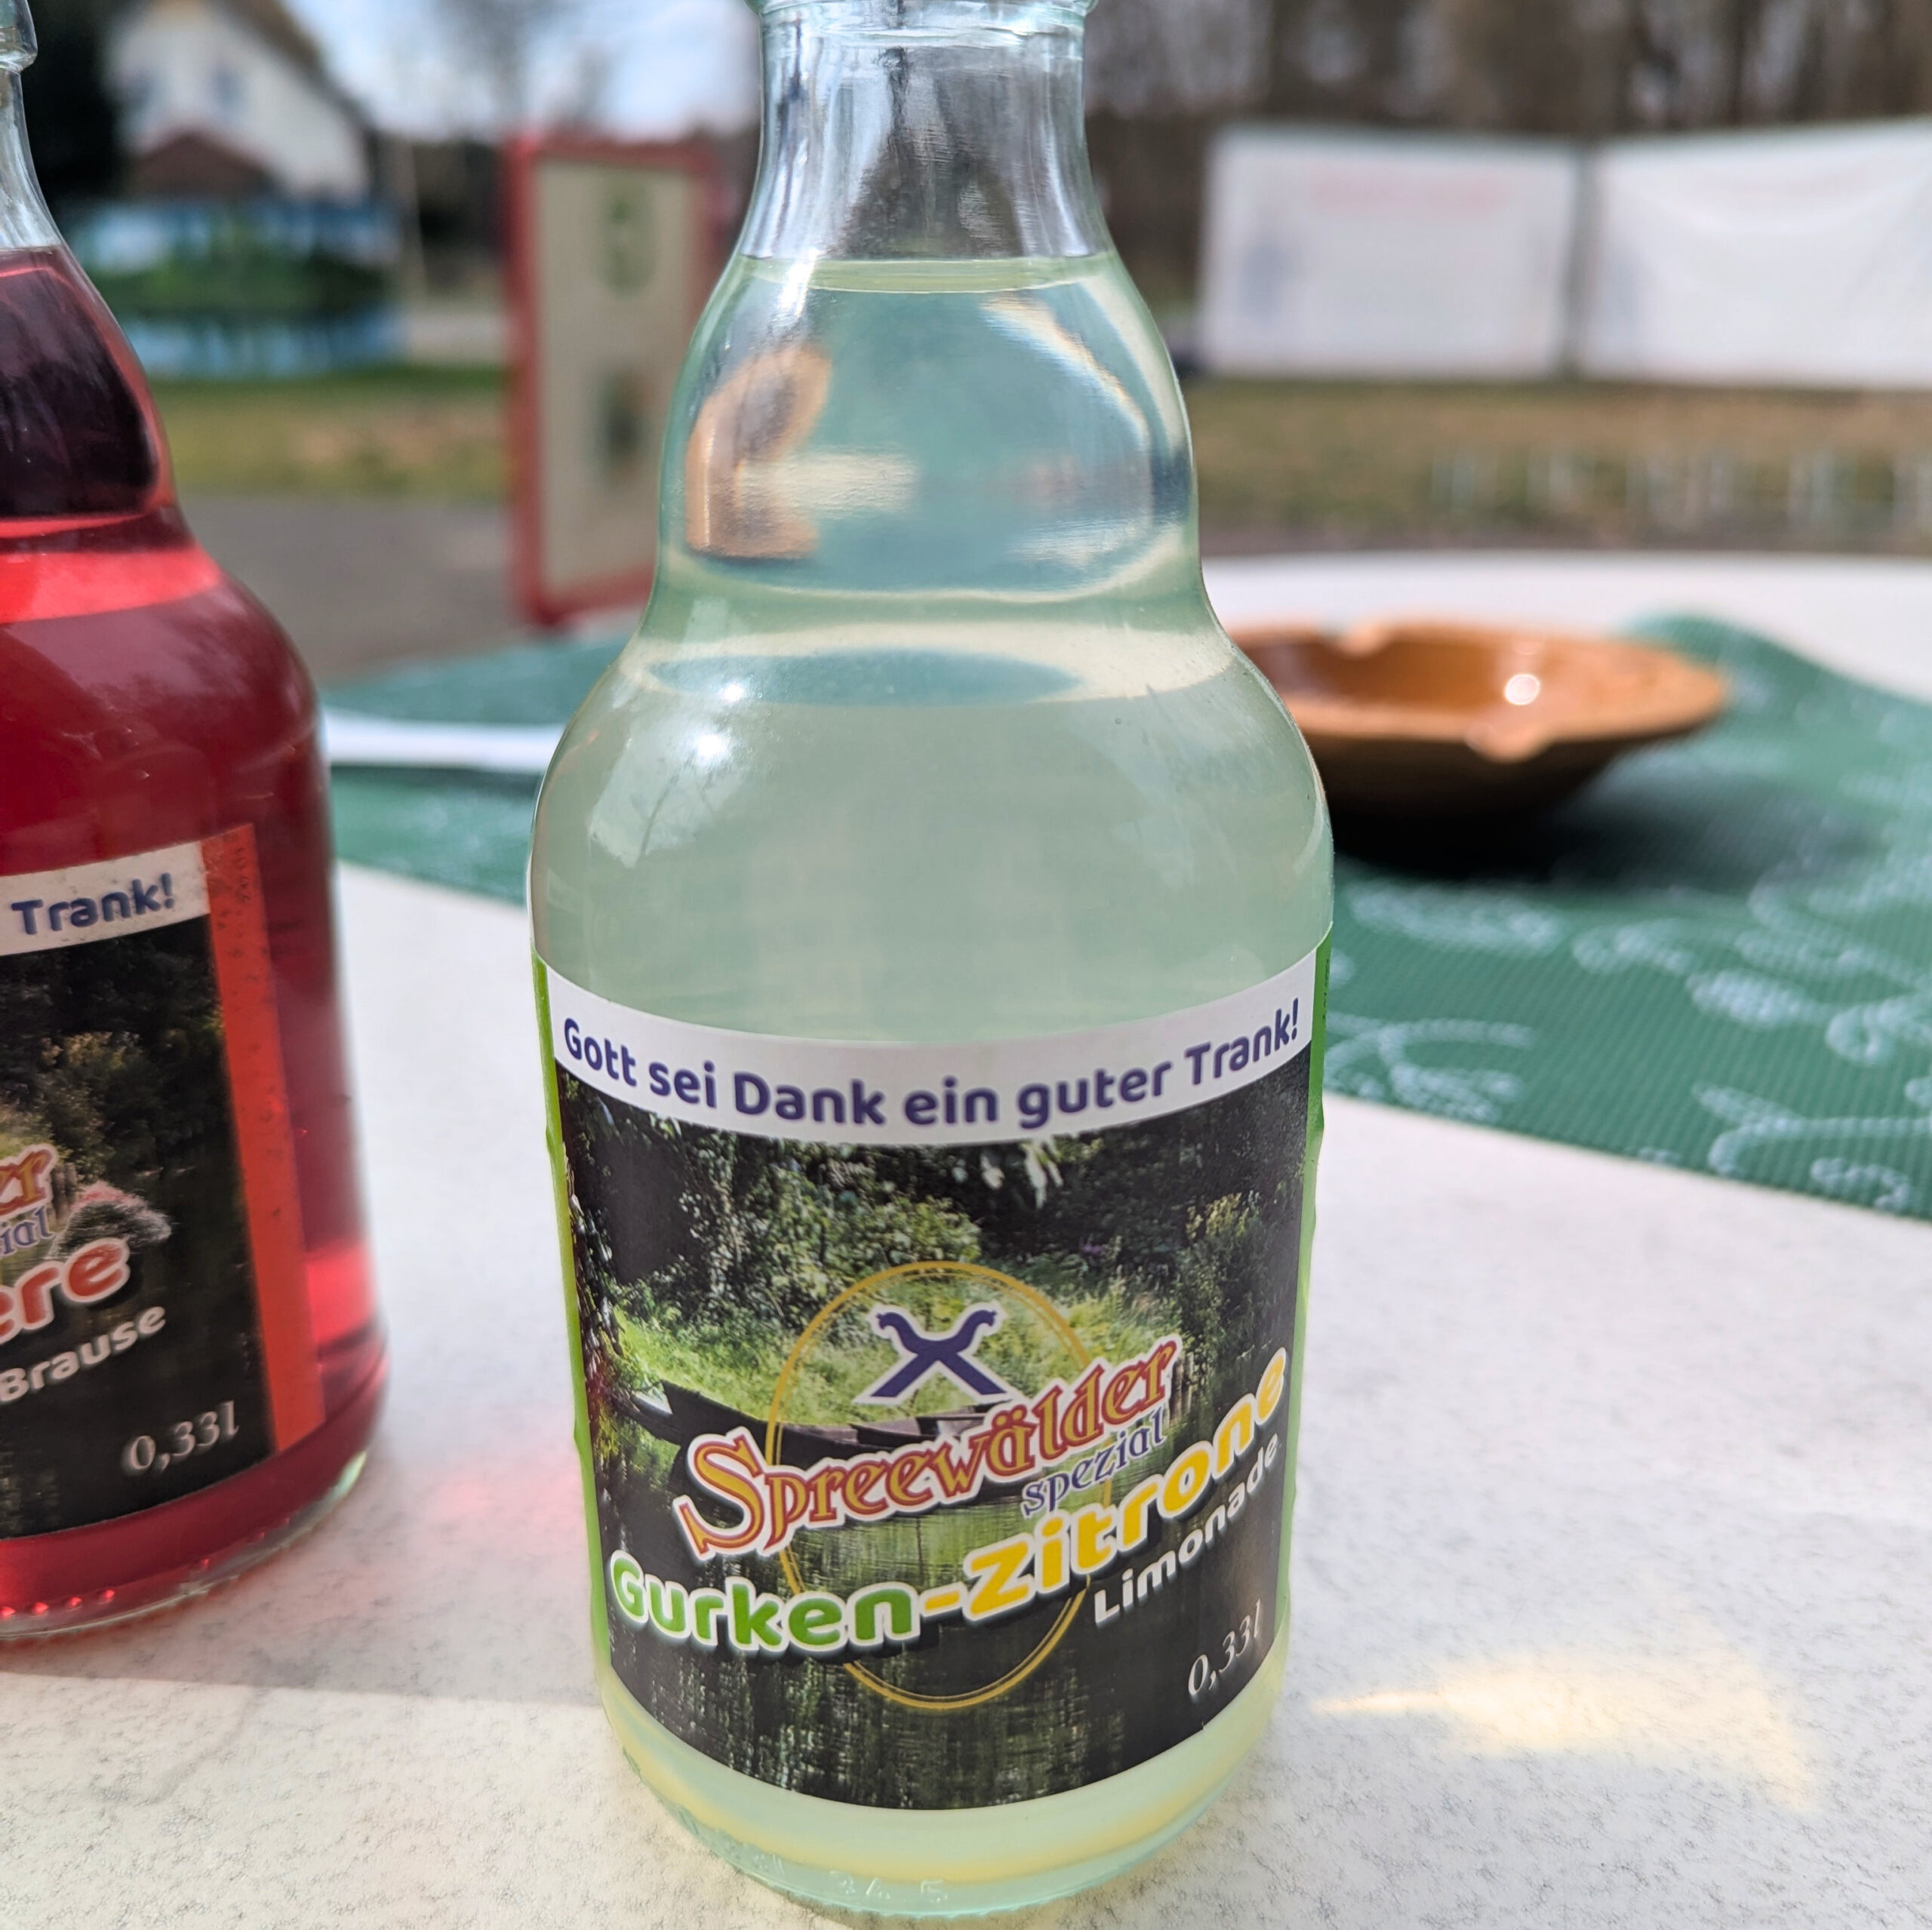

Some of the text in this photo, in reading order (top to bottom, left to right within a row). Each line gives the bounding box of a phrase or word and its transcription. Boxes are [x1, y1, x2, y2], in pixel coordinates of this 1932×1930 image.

[11, 872, 176, 935] Trank!
[563, 997, 1300, 1129] Gott sei Dank ein guter Trank!
[0, 1240, 130, 1343] re
[0, 1305, 165, 1403] Brause
[125, 1400, 240, 1474] 0,33l
[676, 1339, 1179, 1555] Spreewälder
[1022, 1411, 1166, 1519] spezial
[1094, 1434, 1279, 1625] Limonade
[1187, 1598, 1263, 1698] 0,33l
